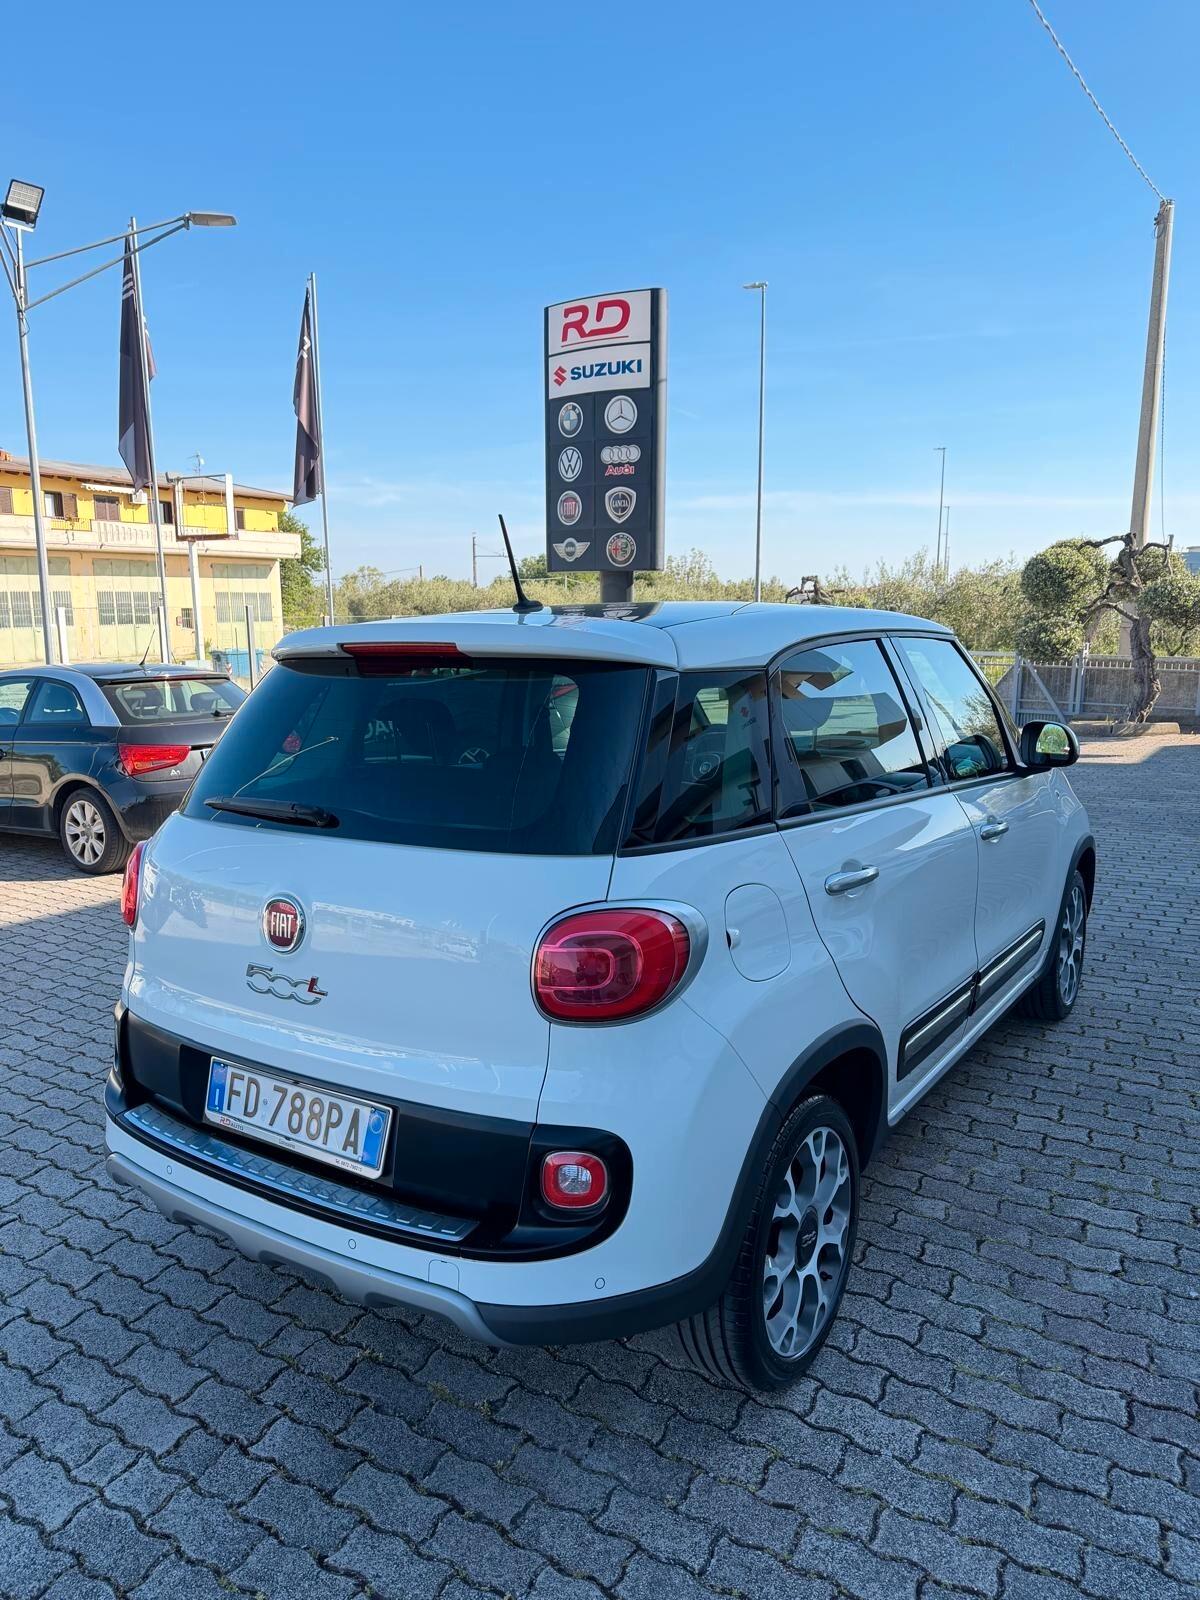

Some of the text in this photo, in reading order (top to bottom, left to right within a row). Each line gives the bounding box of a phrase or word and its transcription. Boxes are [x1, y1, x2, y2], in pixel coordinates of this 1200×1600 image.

[561, 299, 631, 342] RD
[570, 358, 643, 381] SUZUKI
[604, 463, 635, 476] Audi
[563, 502, 576, 515] FIAT
[612, 499, 629, 508] LANCIA
[270, 911, 294, 939] FIAT
